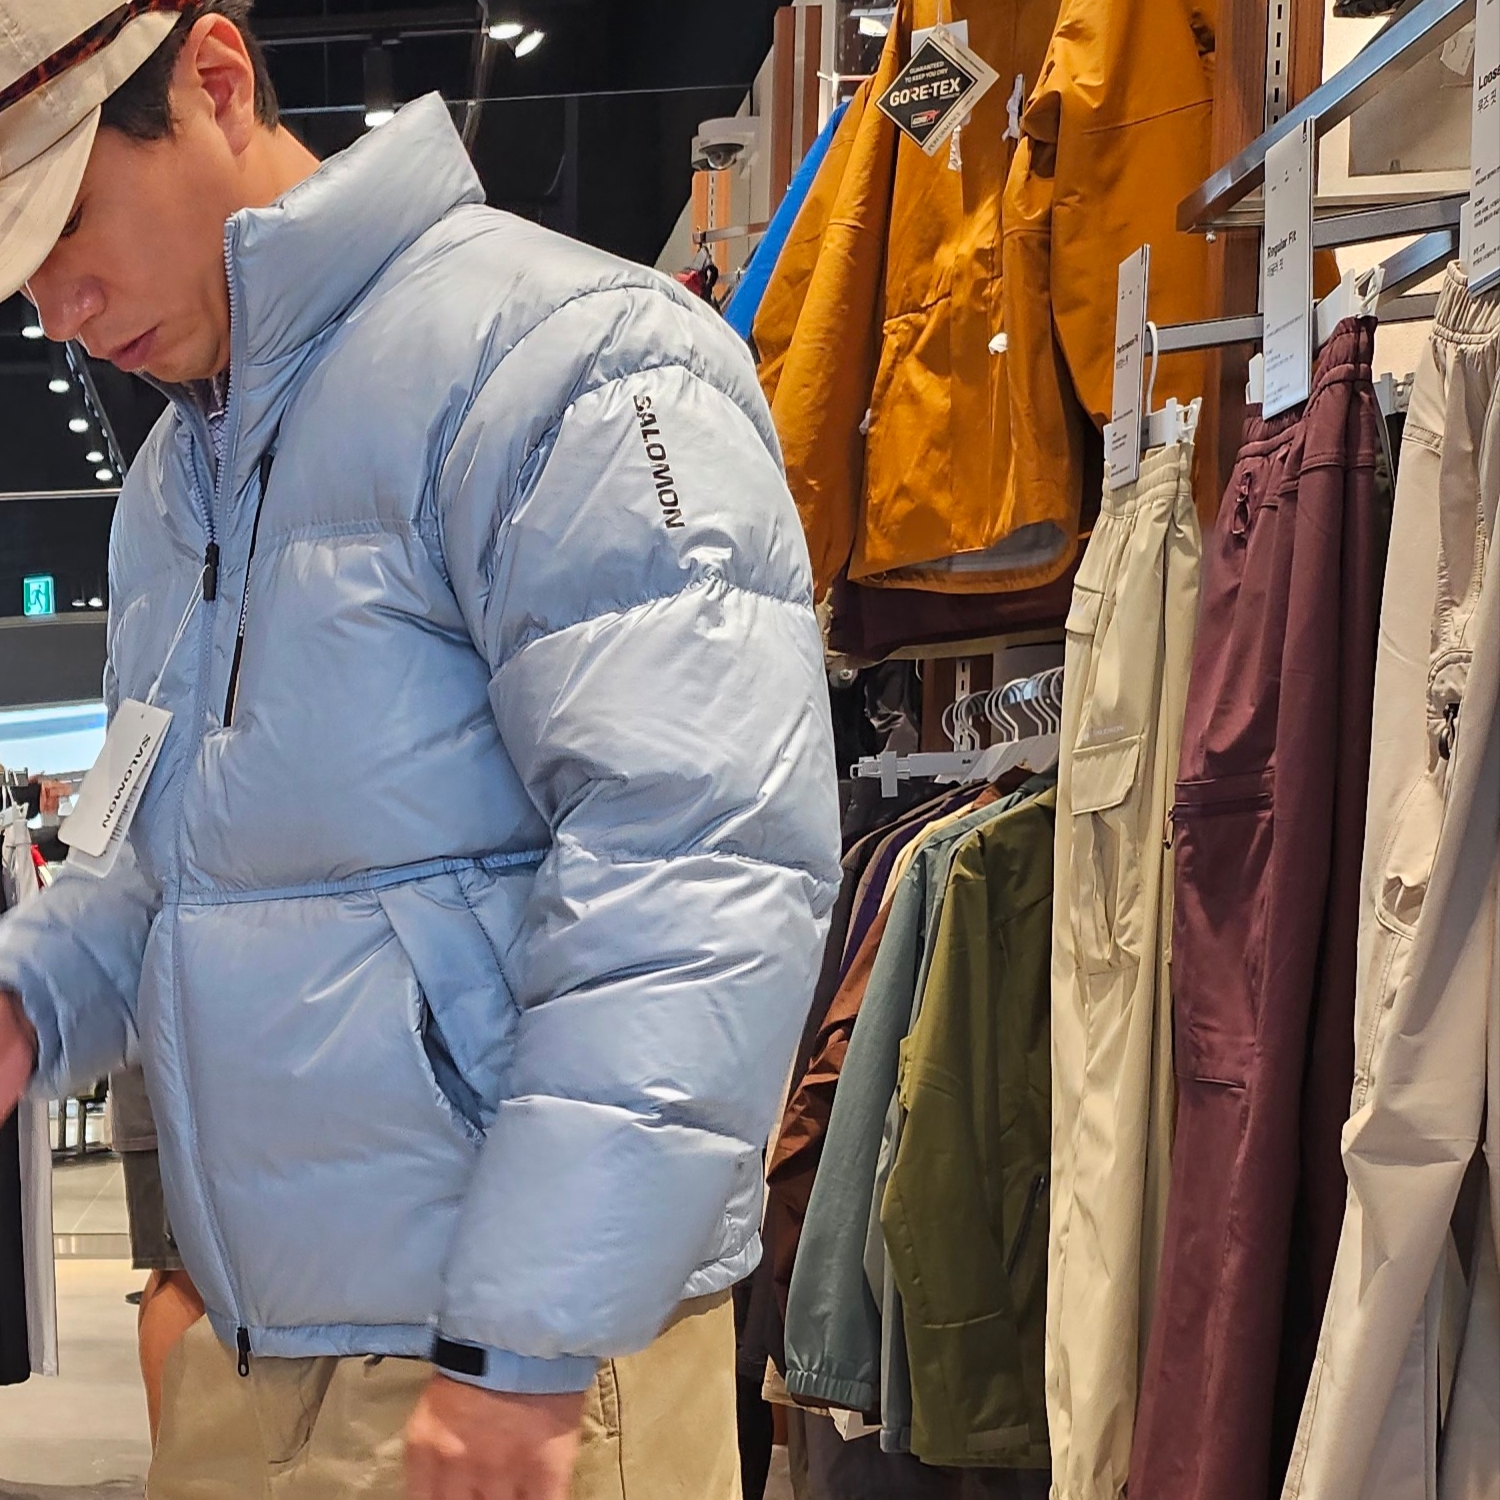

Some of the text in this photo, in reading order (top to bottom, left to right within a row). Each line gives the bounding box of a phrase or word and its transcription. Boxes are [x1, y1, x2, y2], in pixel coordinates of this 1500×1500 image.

[904, 67, 949, 84] TO KEEP YOU DRY
[909, 61, 945, 75] GUARANTEED
[889, 77, 961, 107] GORE-TEX
[1266, 230, 1297, 260] Regular Fit
[633, 394, 686, 529] SALOMON
[102, 733, 151, 829] SALOMON
